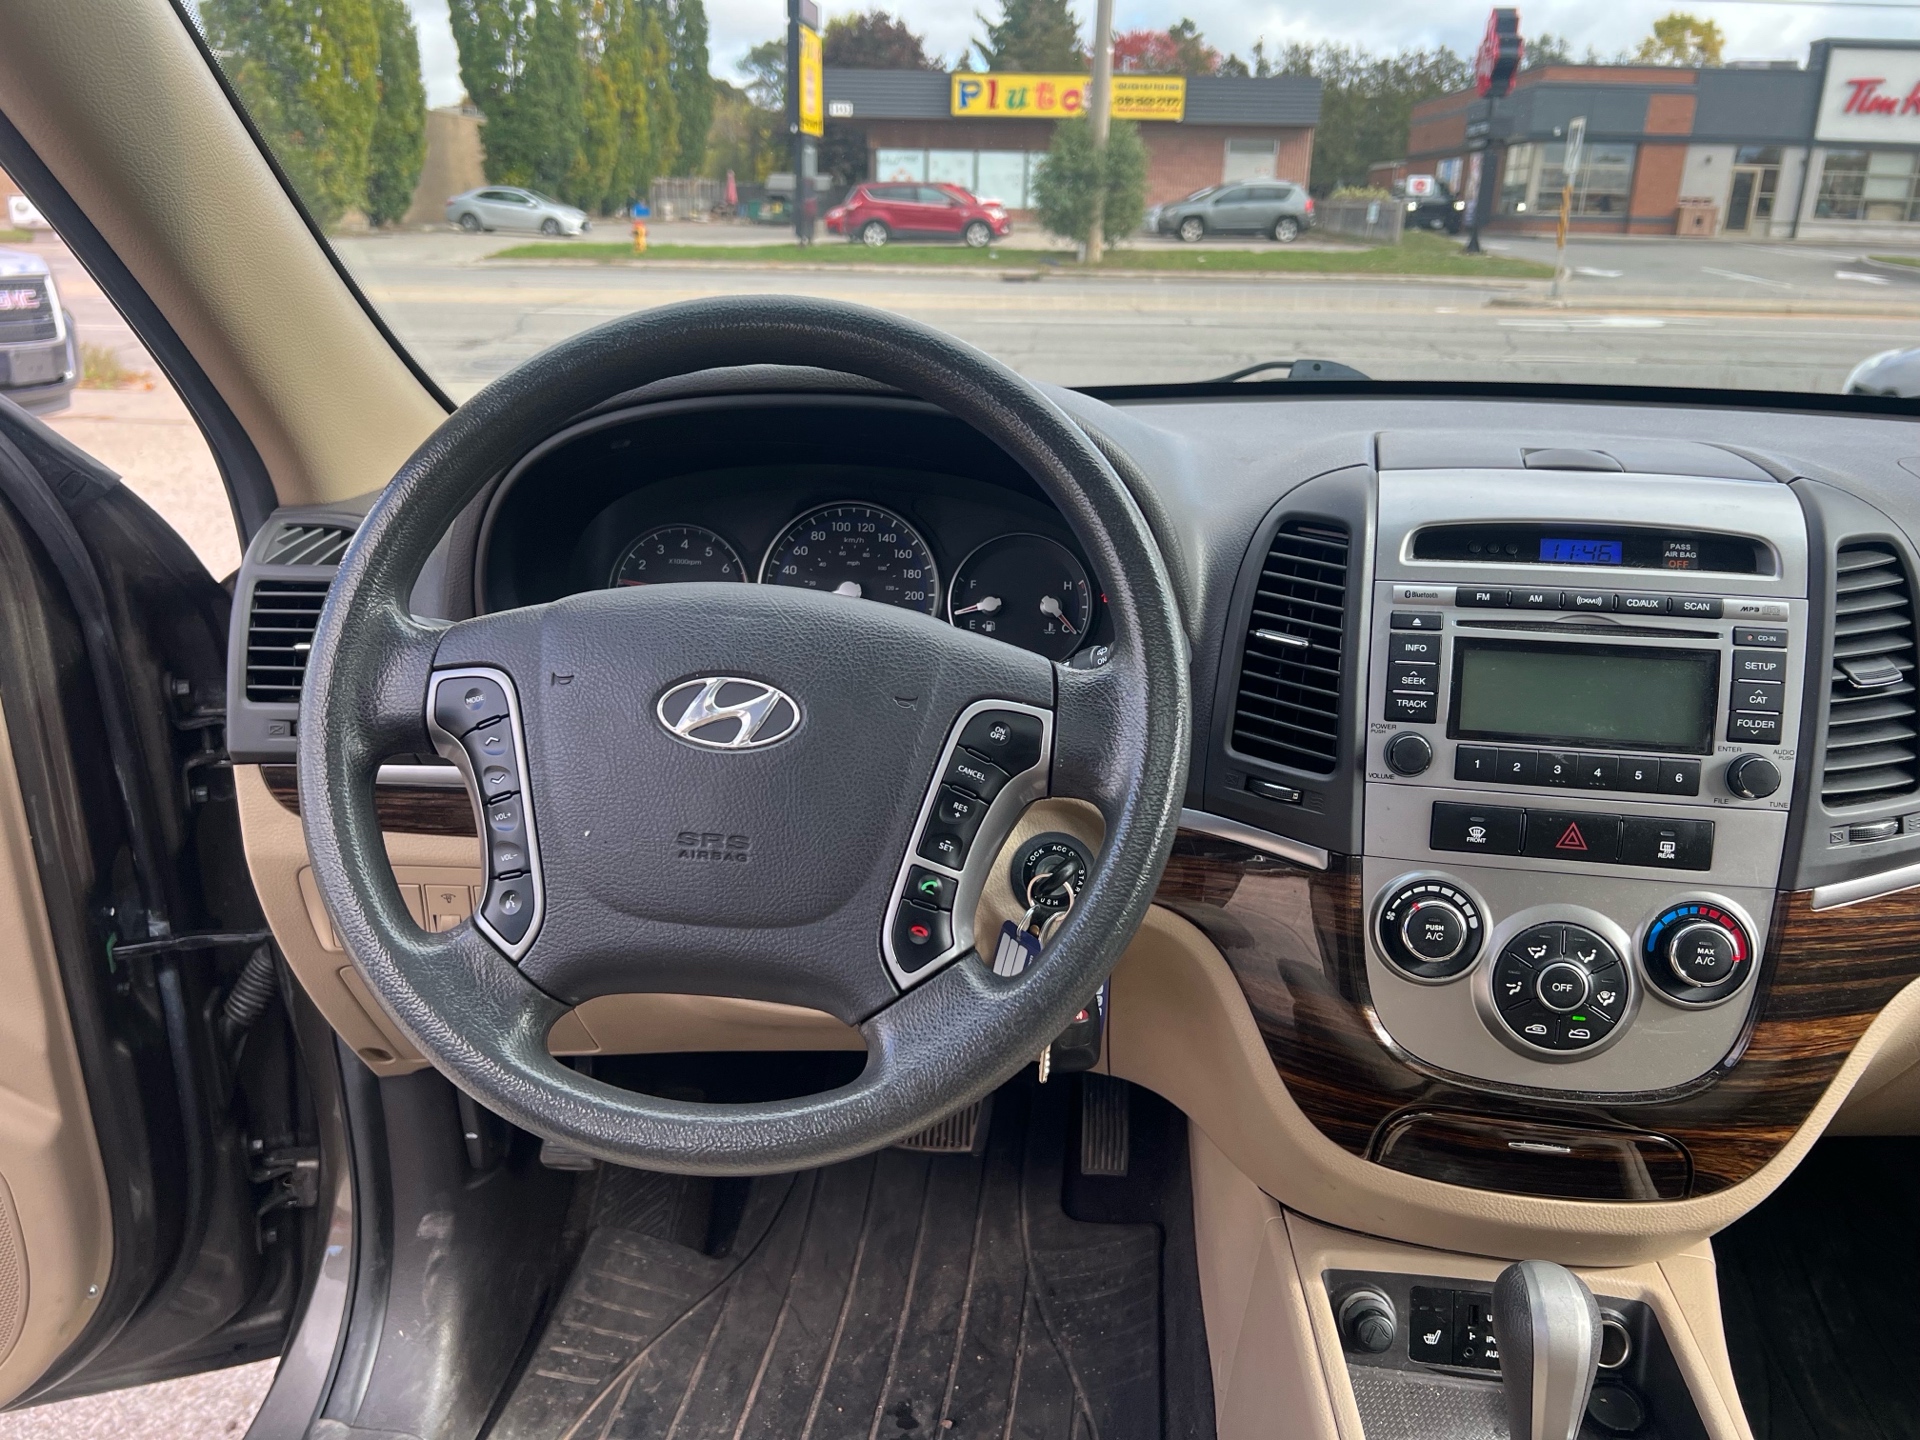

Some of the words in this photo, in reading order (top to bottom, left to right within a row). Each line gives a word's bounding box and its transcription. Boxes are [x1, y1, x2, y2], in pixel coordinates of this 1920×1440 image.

[1844, 77, 1900, 115] Tim
[831, 522, 851, 532] 100
[857, 523, 876, 533] 120
[810, 531, 826, 541] 80
[877, 533, 897, 543] 140
[680, 539, 689, 549] 4
[1670, 543, 1691, 551] PASS
[656, 544, 665, 555] 3
[704, 546, 713, 557] 5
[793, 546, 809, 556] 60
[893, 549, 913, 559] 160
[1552, 543, 1612, 563] 11:46
[638, 559, 647, 570] 2
[721, 563, 730, 574] 6
[1668, 560, 1690, 569] OFF
[782, 565, 798, 575] 40
[903, 569, 922, 579] 180
[970, 580, 977, 589] F
[1063, 581, 1072, 591] H
[904, 591, 925, 601] 200
[1411, 591, 1438, 599] Bluetooth
[1476, 592, 1490, 601] FM
[1528, 595, 1543, 603] AM
[1626, 599, 1659, 608] CD/AUX
[1684, 602, 1710, 611] SCAN
[969, 620, 976, 630] E
[1405, 643, 1427, 652] INFO
[1097, 656, 1107, 665] ON
[1744, 661, 1777, 671] SETUP
[1401, 676, 1426, 685] SEEK
[466, 693, 485, 704] MODE
[1396, 699, 1428, 708] TRACK
[1749, 695, 1768, 705] CAT
[1737, 719, 1775, 729] FOLDER
[994, 726, 1006, 735] ON
[990, 731, 1006, 741] OFF
[1474, 759, 1481, 769] 1
[1513, 762, 1521, 772] 2
[958, 765, 985, 781] CANCEL
[1553, 765, 1561, 774] 3
[1593, 768, 1602, 778] 4
[1368, 772, 1395, 780] VOLUME
[1634, 771, 1642, 780] 5
[1675, 773, 1683, 783] 6
[953, 801, 968, 813] RES
[677, 831, 750, 851] SRS
[938, 842, 954, 853] SET
[1051, 845, 1067, 853] ACC
[678, 849, 748, 862] AIRBAG
[1026, 848, 1045, 866] LOCK
[1657, 852, 1675, 860] REAR
[1039, 898, 1059, 906] USH
[1425, 931, 1444, 941] A/C
[1695, 955, 1716, 966] A/C
[1552, 983, 1573, 993] OFF
